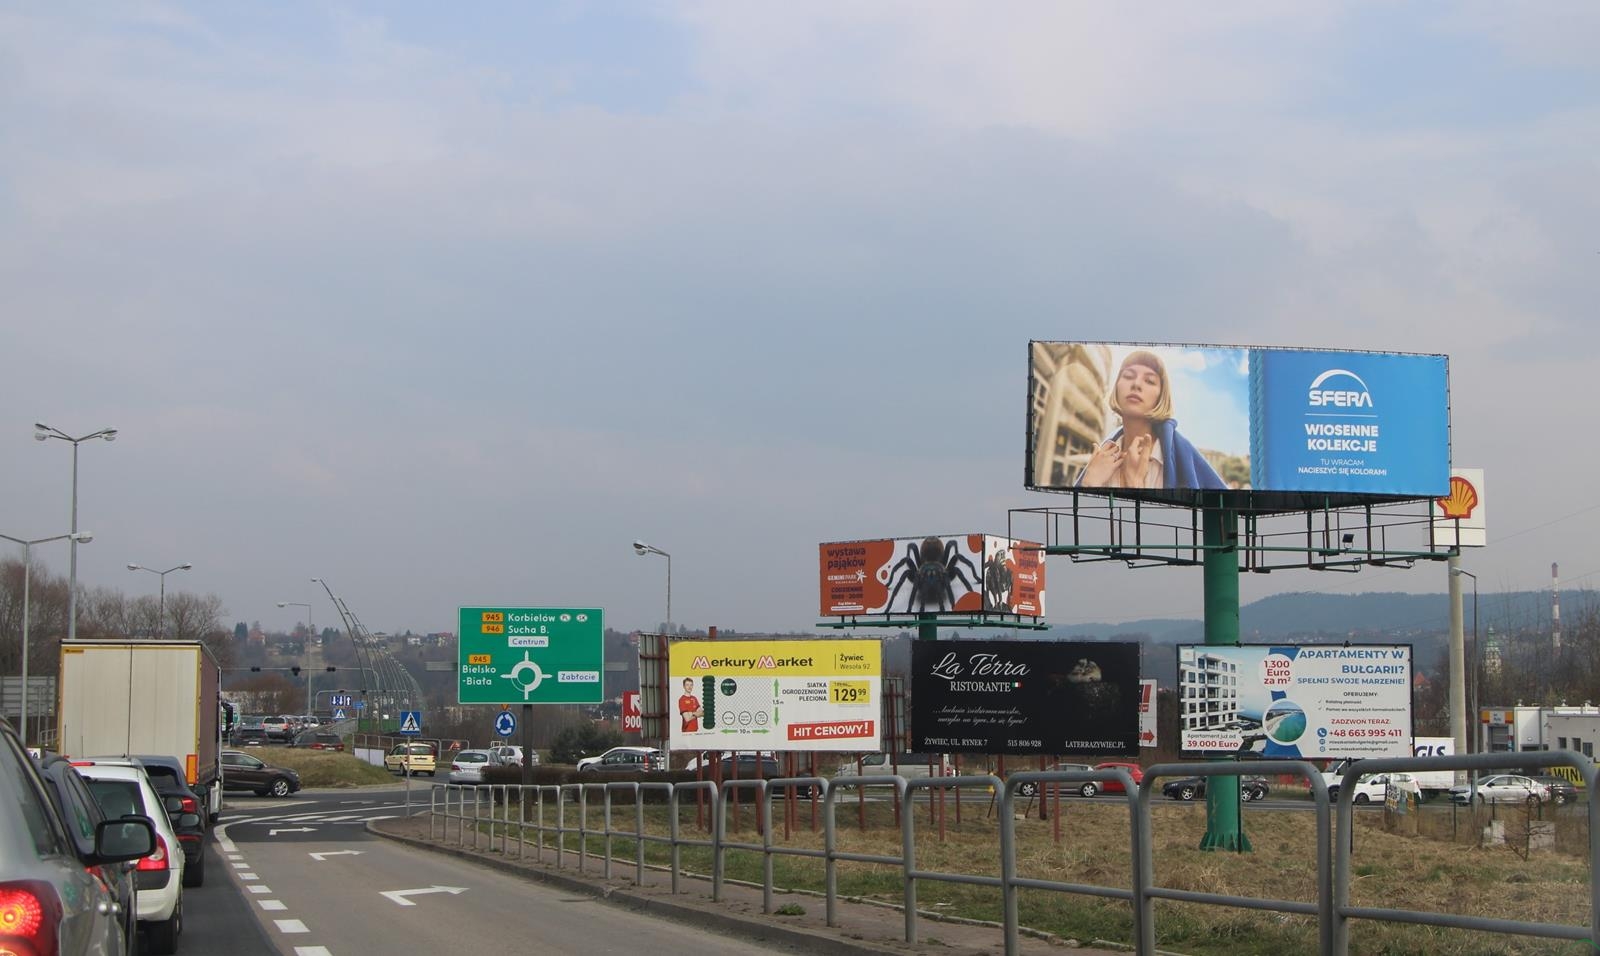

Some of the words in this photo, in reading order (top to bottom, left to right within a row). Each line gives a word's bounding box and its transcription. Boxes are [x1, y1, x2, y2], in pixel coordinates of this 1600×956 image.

[1309, 390, 1373, 408] SFERA
[1304, 423, 1379, 437] WIOSENNE
[1307, 439, 1377, 452] KOLEKCJE
[1320, 458, 1330, 466] TU
[1331, 458, 1365, 466] WRACAM
[1298, 466, 1338, 474] NACIESZYĆ
[1338, 467, 1350, 476] SIĘ
[1350, 467, 1387, 476] KOLORAMI
[827, 547, 866, 558] wystawa
[827, 557, 866, 570] pająków
[485, 613, 500, 621] 945
[508, 613, 556, 623] Korbielów
[486, 625, 500, 633] 946
[508, 625, 537, 634] Sucha
[540, 625, 549, 634] B.
[512, 638, 546, 646] Centrum
[840, 653, 864, 662] Żywiec
[1300, 650, 1388, 659] APARTAMENTY
[1391, 650, 1404, 659] W
[691, 655, 756, 671] Merkury
[757, 654, 813, 670] Market
[840, 663, 862, 671] Wesoła
[930, 651, 965, 680] La
[969, 653, 1031, 677] Terra
[1264, 660, 1290, 669] 1.300
[462, 665, 497, 674] Bielsko
[1266, 668, 1291, 677] Euro
[1341, 664, 1405, 674] BUŁGARII?
[561, 672, 596, 681] Zabłocie
[462, 677, 492, 686] -Biała
[950, 681, 1011, 692] RISTORANTE
[782, 688, 827, 696] OGRODZENIOWA
[834, 688, 858, 702] 129
[858, 688, 867, 696] 99
[793, 727, 811, 737] HIT
[814, 721, 869, 736] CENOWY!
[1329, 729, 1346, 737] +48
[1348, 729, 1366, 737] 663
[1368, 729, 1386, 737] 995
[1387, 729, 1402, 737] 411
[924, 737, 950, 747] ŻYWIEC,
[950, 739, 961, 747] UL.
[962, 738, 982, 747] RYNEK
[1007, 739, 1018, 747] 515
[1018, 739, 1030, 747] 806
[1030, 739, 1042, 748] 928
[1065, 740, 1126, 749] LATERRAZYWIEC.PL
[1187, 740, 1217, 748] 39.000
[1218, 740, 1239, 748] Euro
